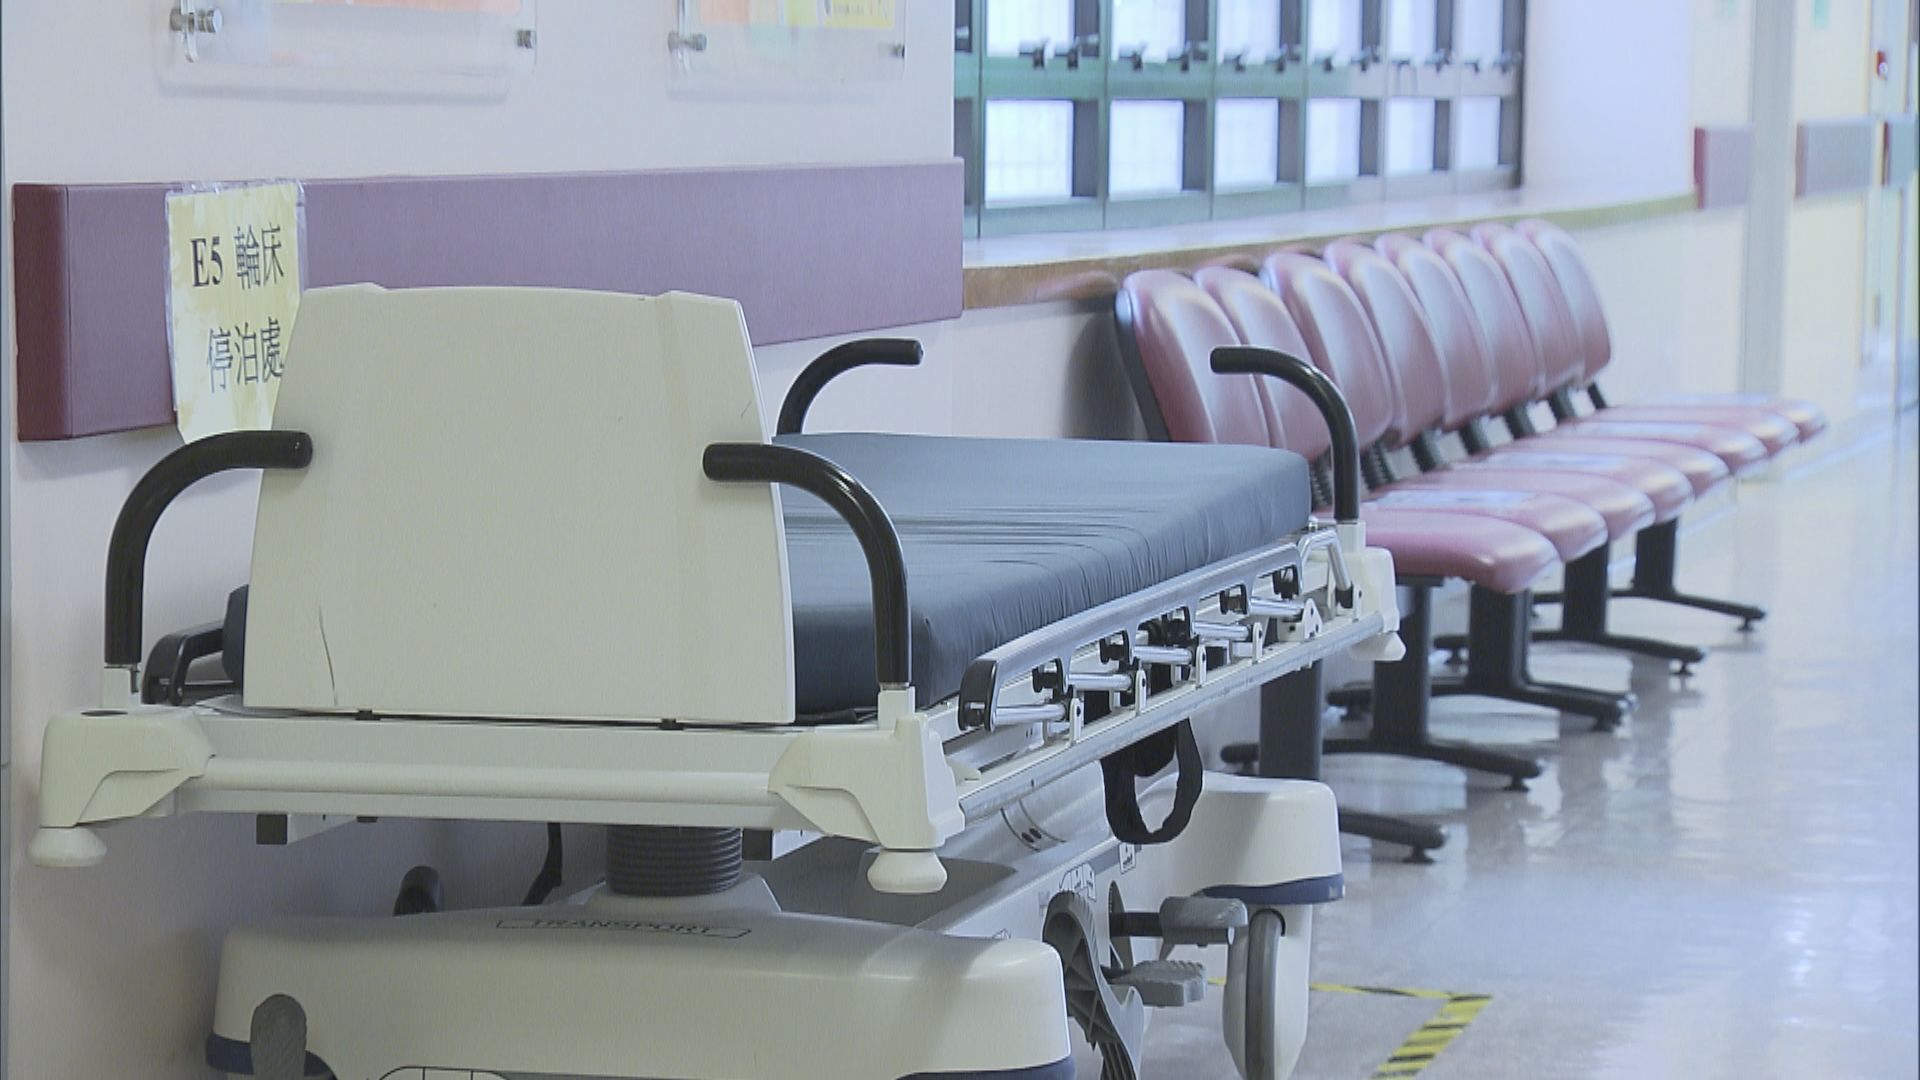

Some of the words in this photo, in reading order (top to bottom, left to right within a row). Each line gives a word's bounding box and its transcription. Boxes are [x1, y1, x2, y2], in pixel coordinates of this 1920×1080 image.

[190, 236, 224, 288] E5
[234, 221, 284, 290] 輪床
[207, 316, 284, 393] 停泊處
[533, 919, 713, 934] TRANSPORT
